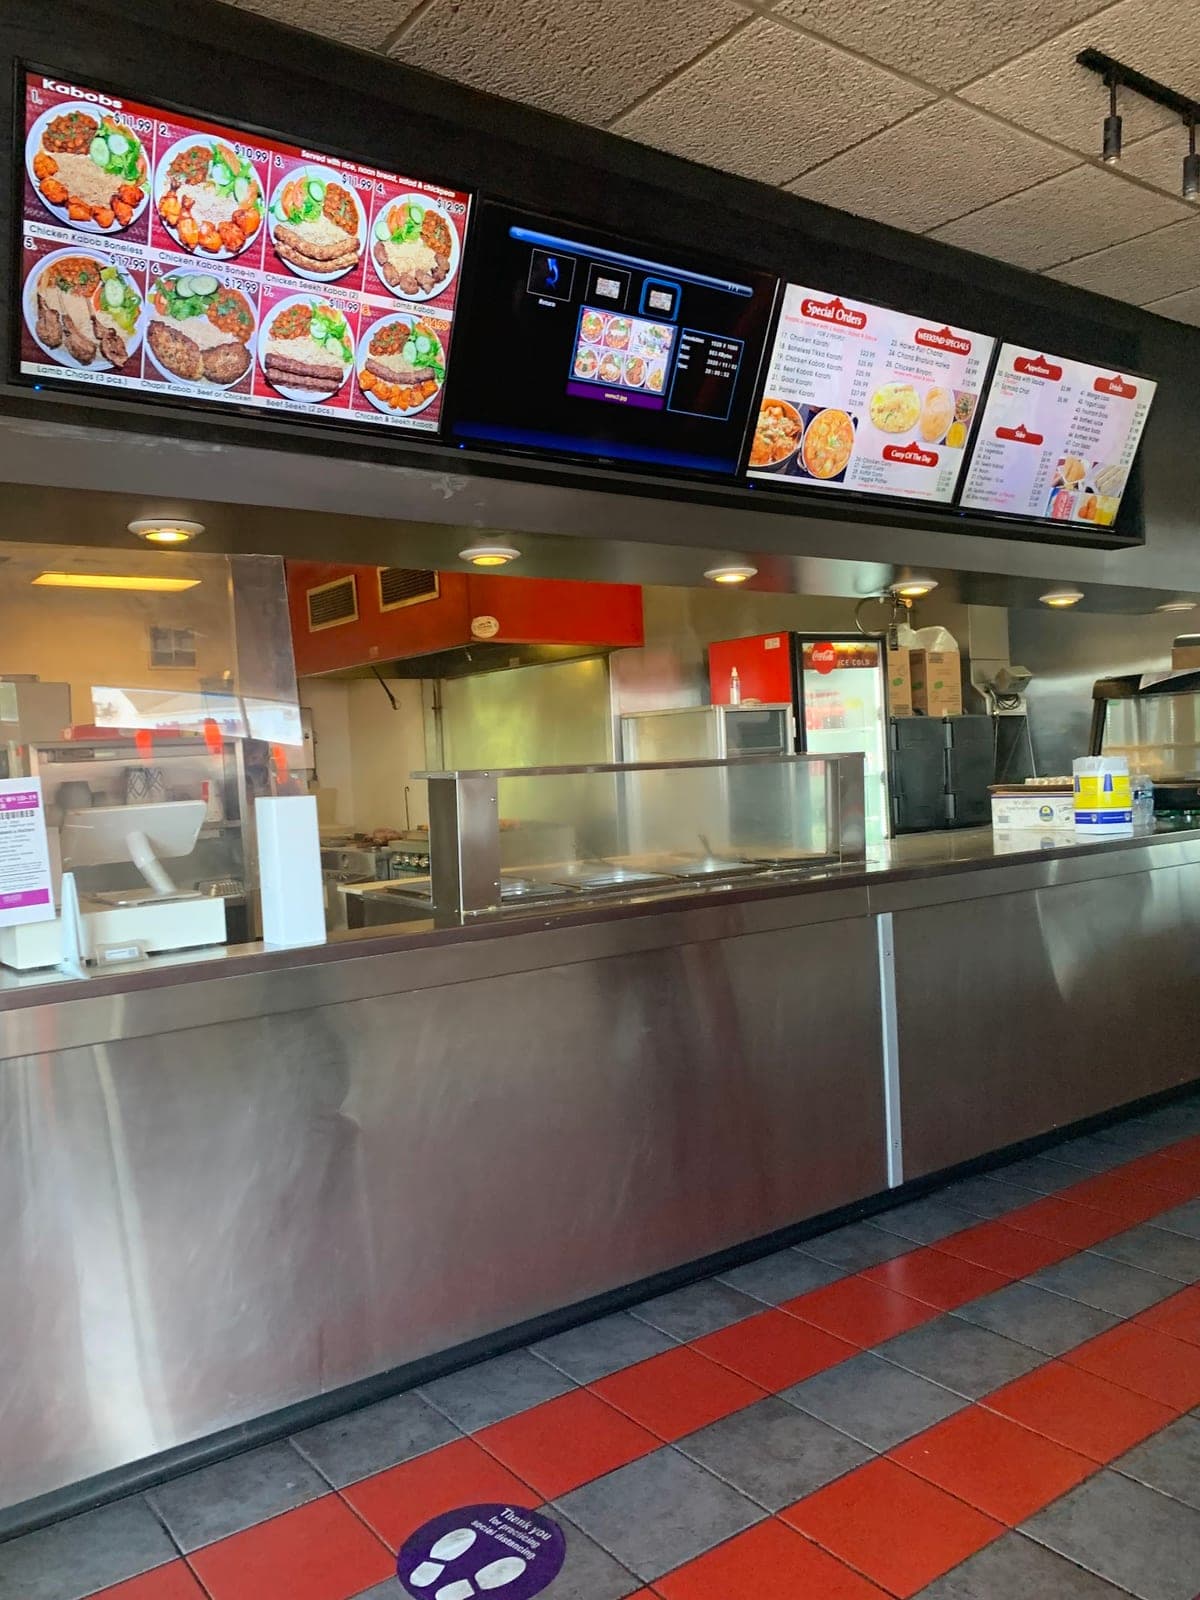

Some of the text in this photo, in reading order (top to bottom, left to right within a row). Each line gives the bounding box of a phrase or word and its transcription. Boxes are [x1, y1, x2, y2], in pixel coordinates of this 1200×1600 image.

[42, 78, 123, 109] Kabobs
[113, 111, 152, 132] $11.99
[234, 143, 268, 162] $10.99
[301, 150, 326, 163] Served
[326, 156, 340, 168] with
[342, 172, 372, 191] $11.99
[437, 198, 466, 214] $12.99
[28, 224, 145, 256] Chicken Kabob Boneless
[109, 253, 147, 271] $17.99
[158, 251, 256, 279] Chicken Kabob Bone-in
[224, 277, 258, 295] $12.99
[265, 274, 298, 288] Chicken
[299, 280, 322, 292] Seekh
[322, 286, 348, 298] Kabob
[328, 297, 360, 313] $11.99
[392, 301, 436, 316] Lamb Kabob
[806, 302, 835, 320] Special
[834, 308, 862, 326] Orders
[789, 333, 812, 344] Chicken
[784, 354, 808, 365] Chicken
[808, 359, 826, 369] Kabob
[894, 362, 915, 372] Chicken
[37, 365, 63, 377] Lamb
[64, 369, 95, 381] Chops
[167, 384, 192, 395] Kabob
[223, 391, 253, 402] Chicken
[265, 398, 284, 408] Beef
[355, 411, 384, 422] Chicken
[851, 659, 871, 667] COLD
[470, 1519, 498, 1536] social
[488, 1515, 542, 1550] for practicing
[500, 1507, 553, 1541] Thank you
